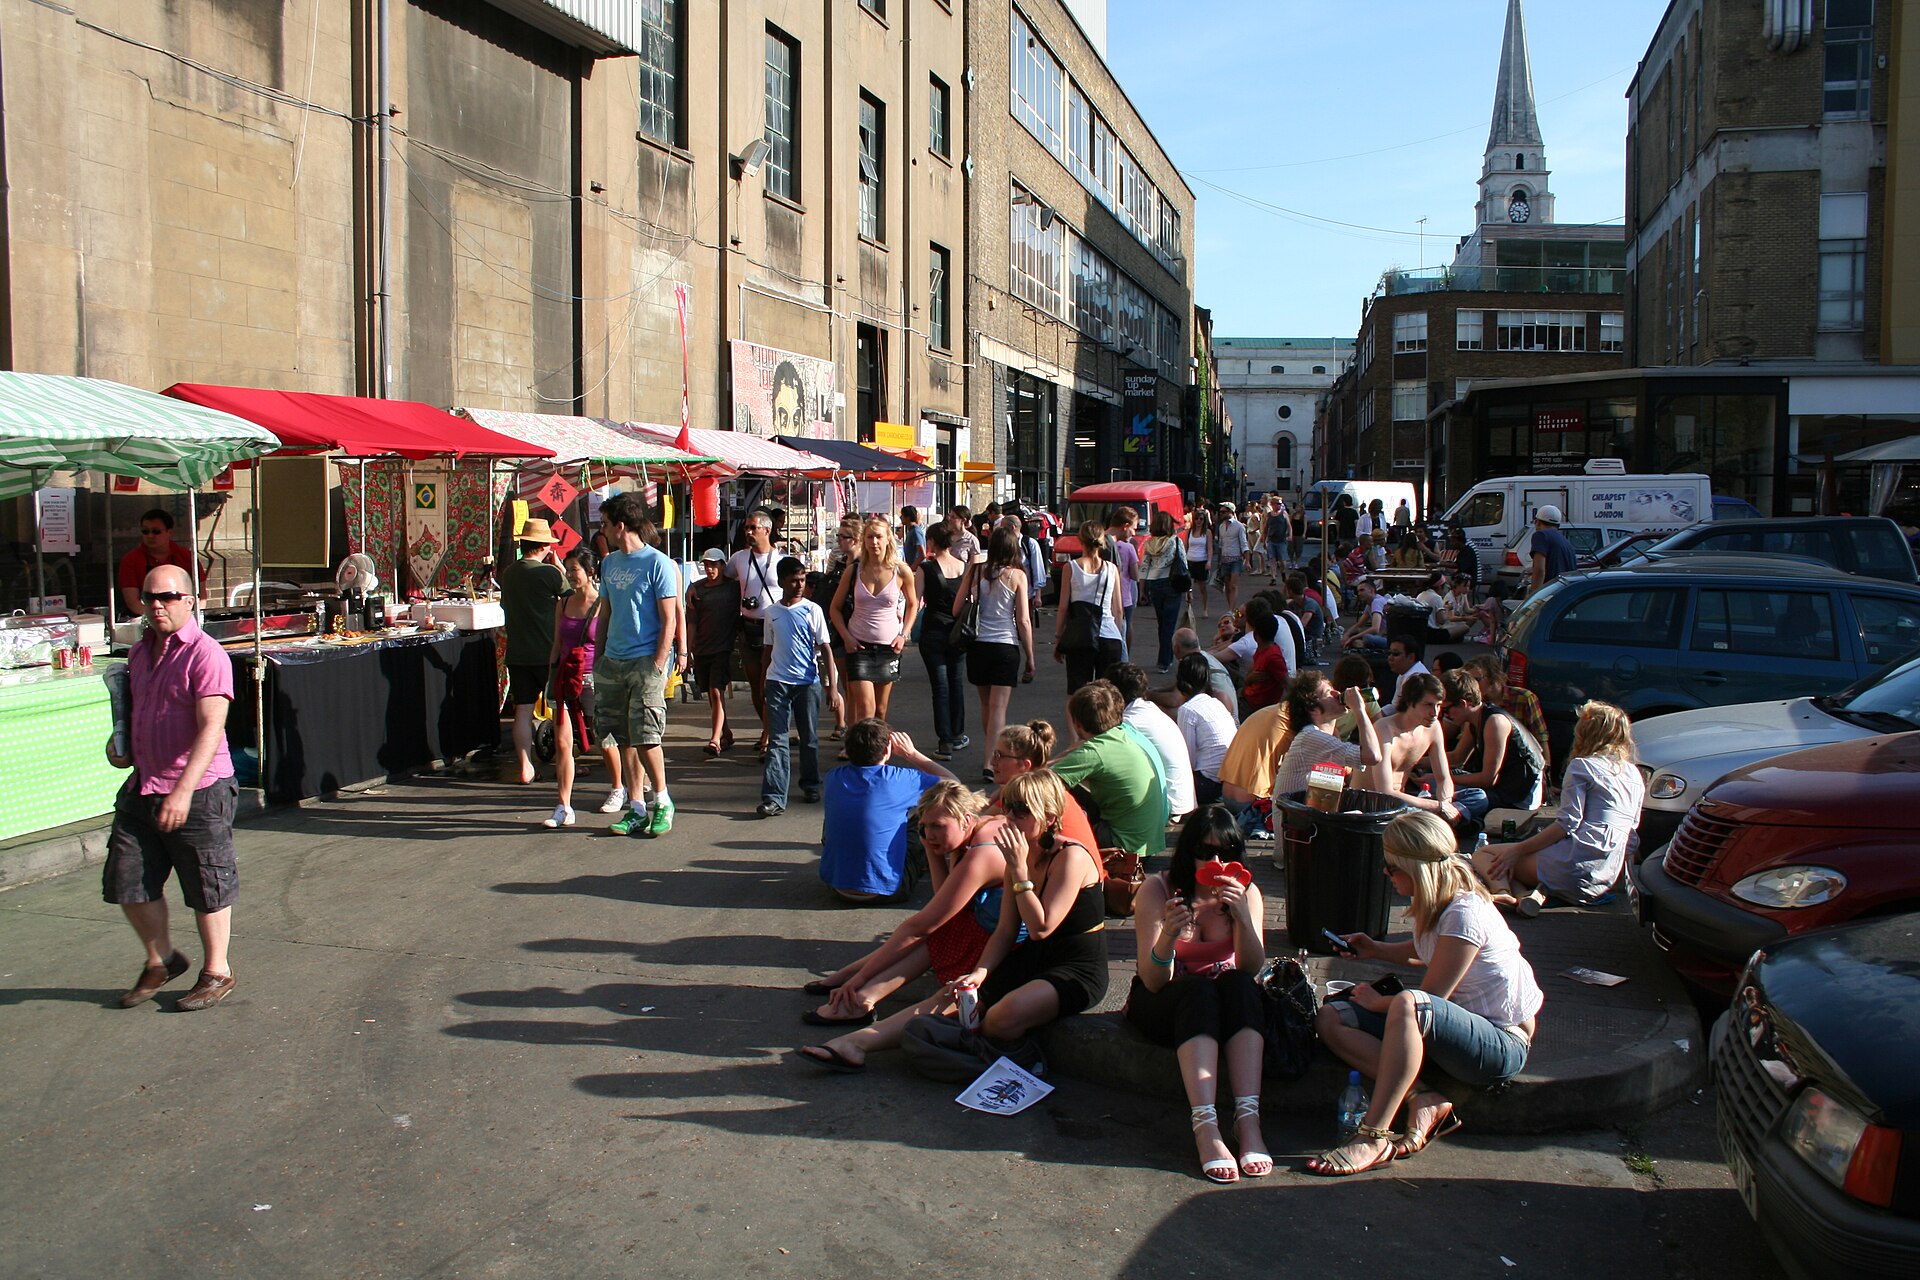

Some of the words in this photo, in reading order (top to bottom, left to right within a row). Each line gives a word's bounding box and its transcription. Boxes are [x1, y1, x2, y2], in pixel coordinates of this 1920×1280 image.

[1124, 374, 1157, 384] sunday
[1127, 382, 1139, 390] up
[1124, 388, 1155, 397] market
[1591, 493, 1626, 501] CHEAPEST
[1604, 502, 1613, 510] IN
[1593, 511, 1624, 519] LONDON
[605, 567, 642, 584] Lucky
